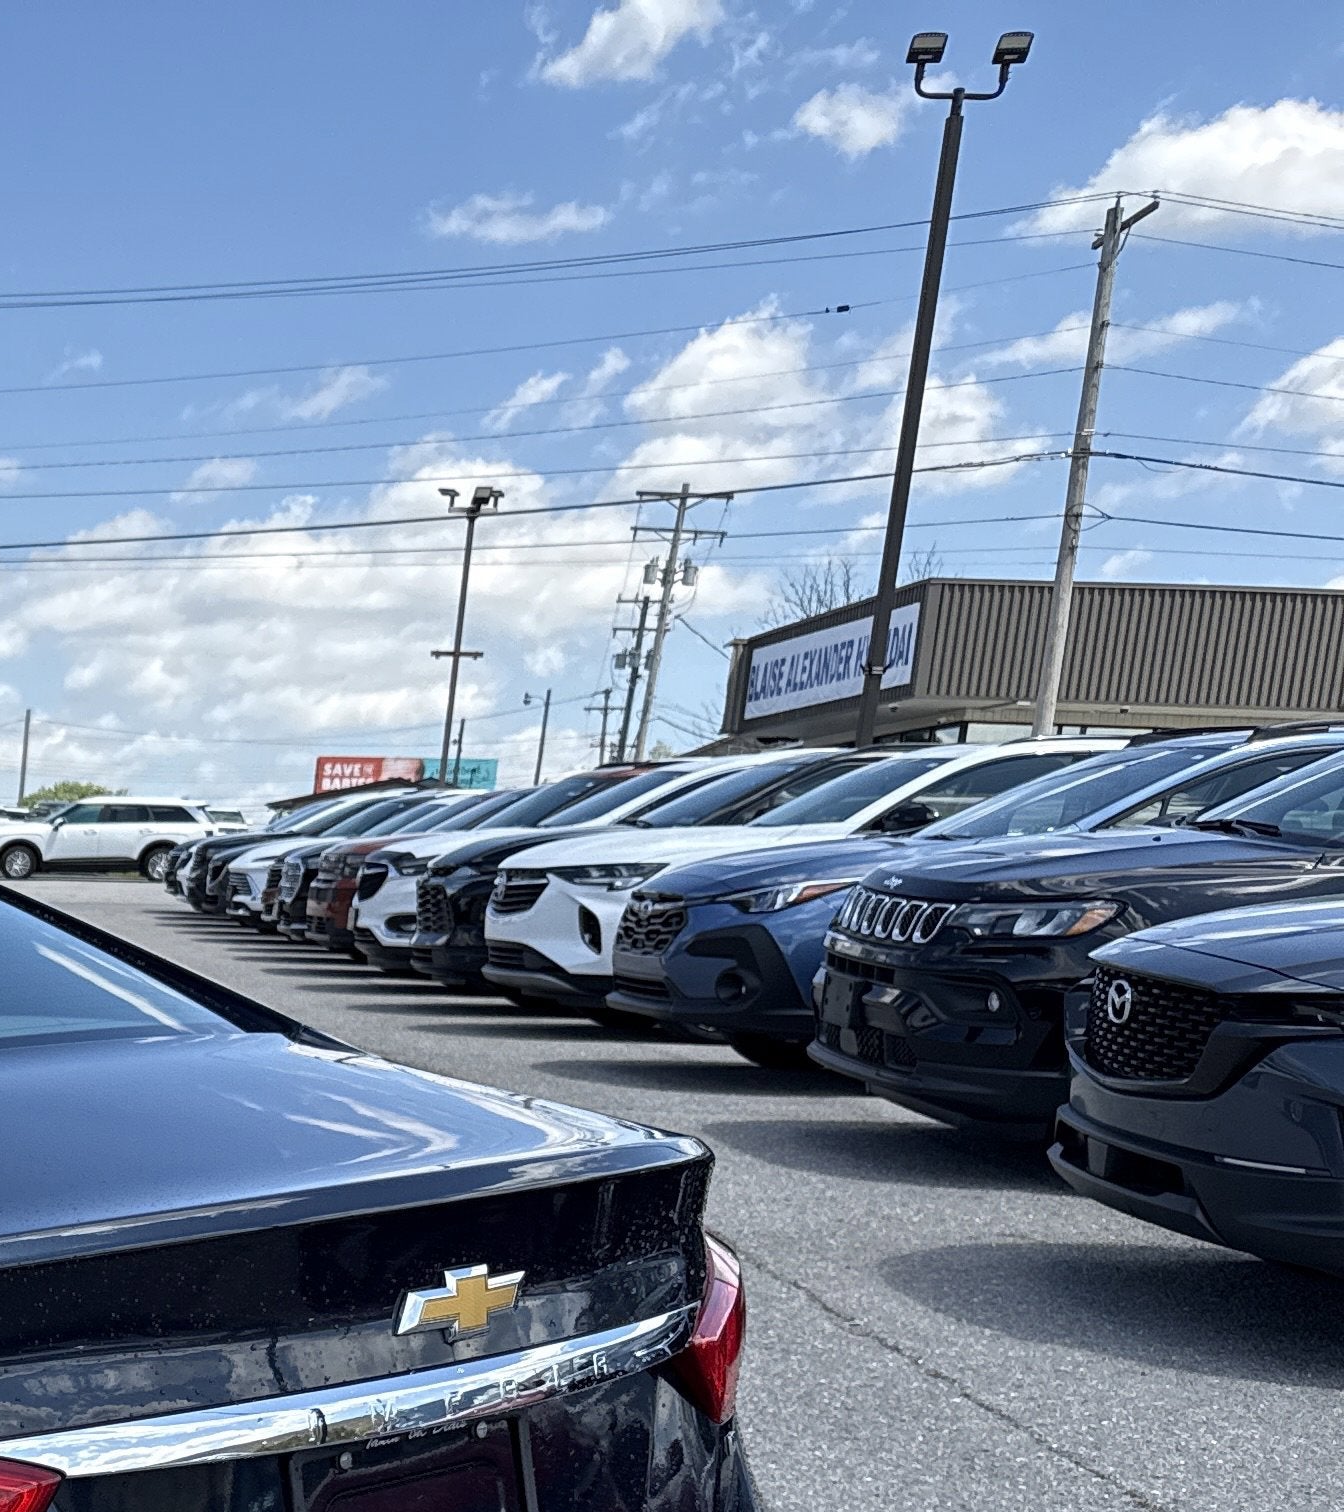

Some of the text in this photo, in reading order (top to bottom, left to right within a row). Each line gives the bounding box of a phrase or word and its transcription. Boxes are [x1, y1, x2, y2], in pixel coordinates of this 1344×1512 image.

[748, 622, 913, 703] BLAISE ALEXANDER HYDAI
[323, 763, 362, 777] SAVE
